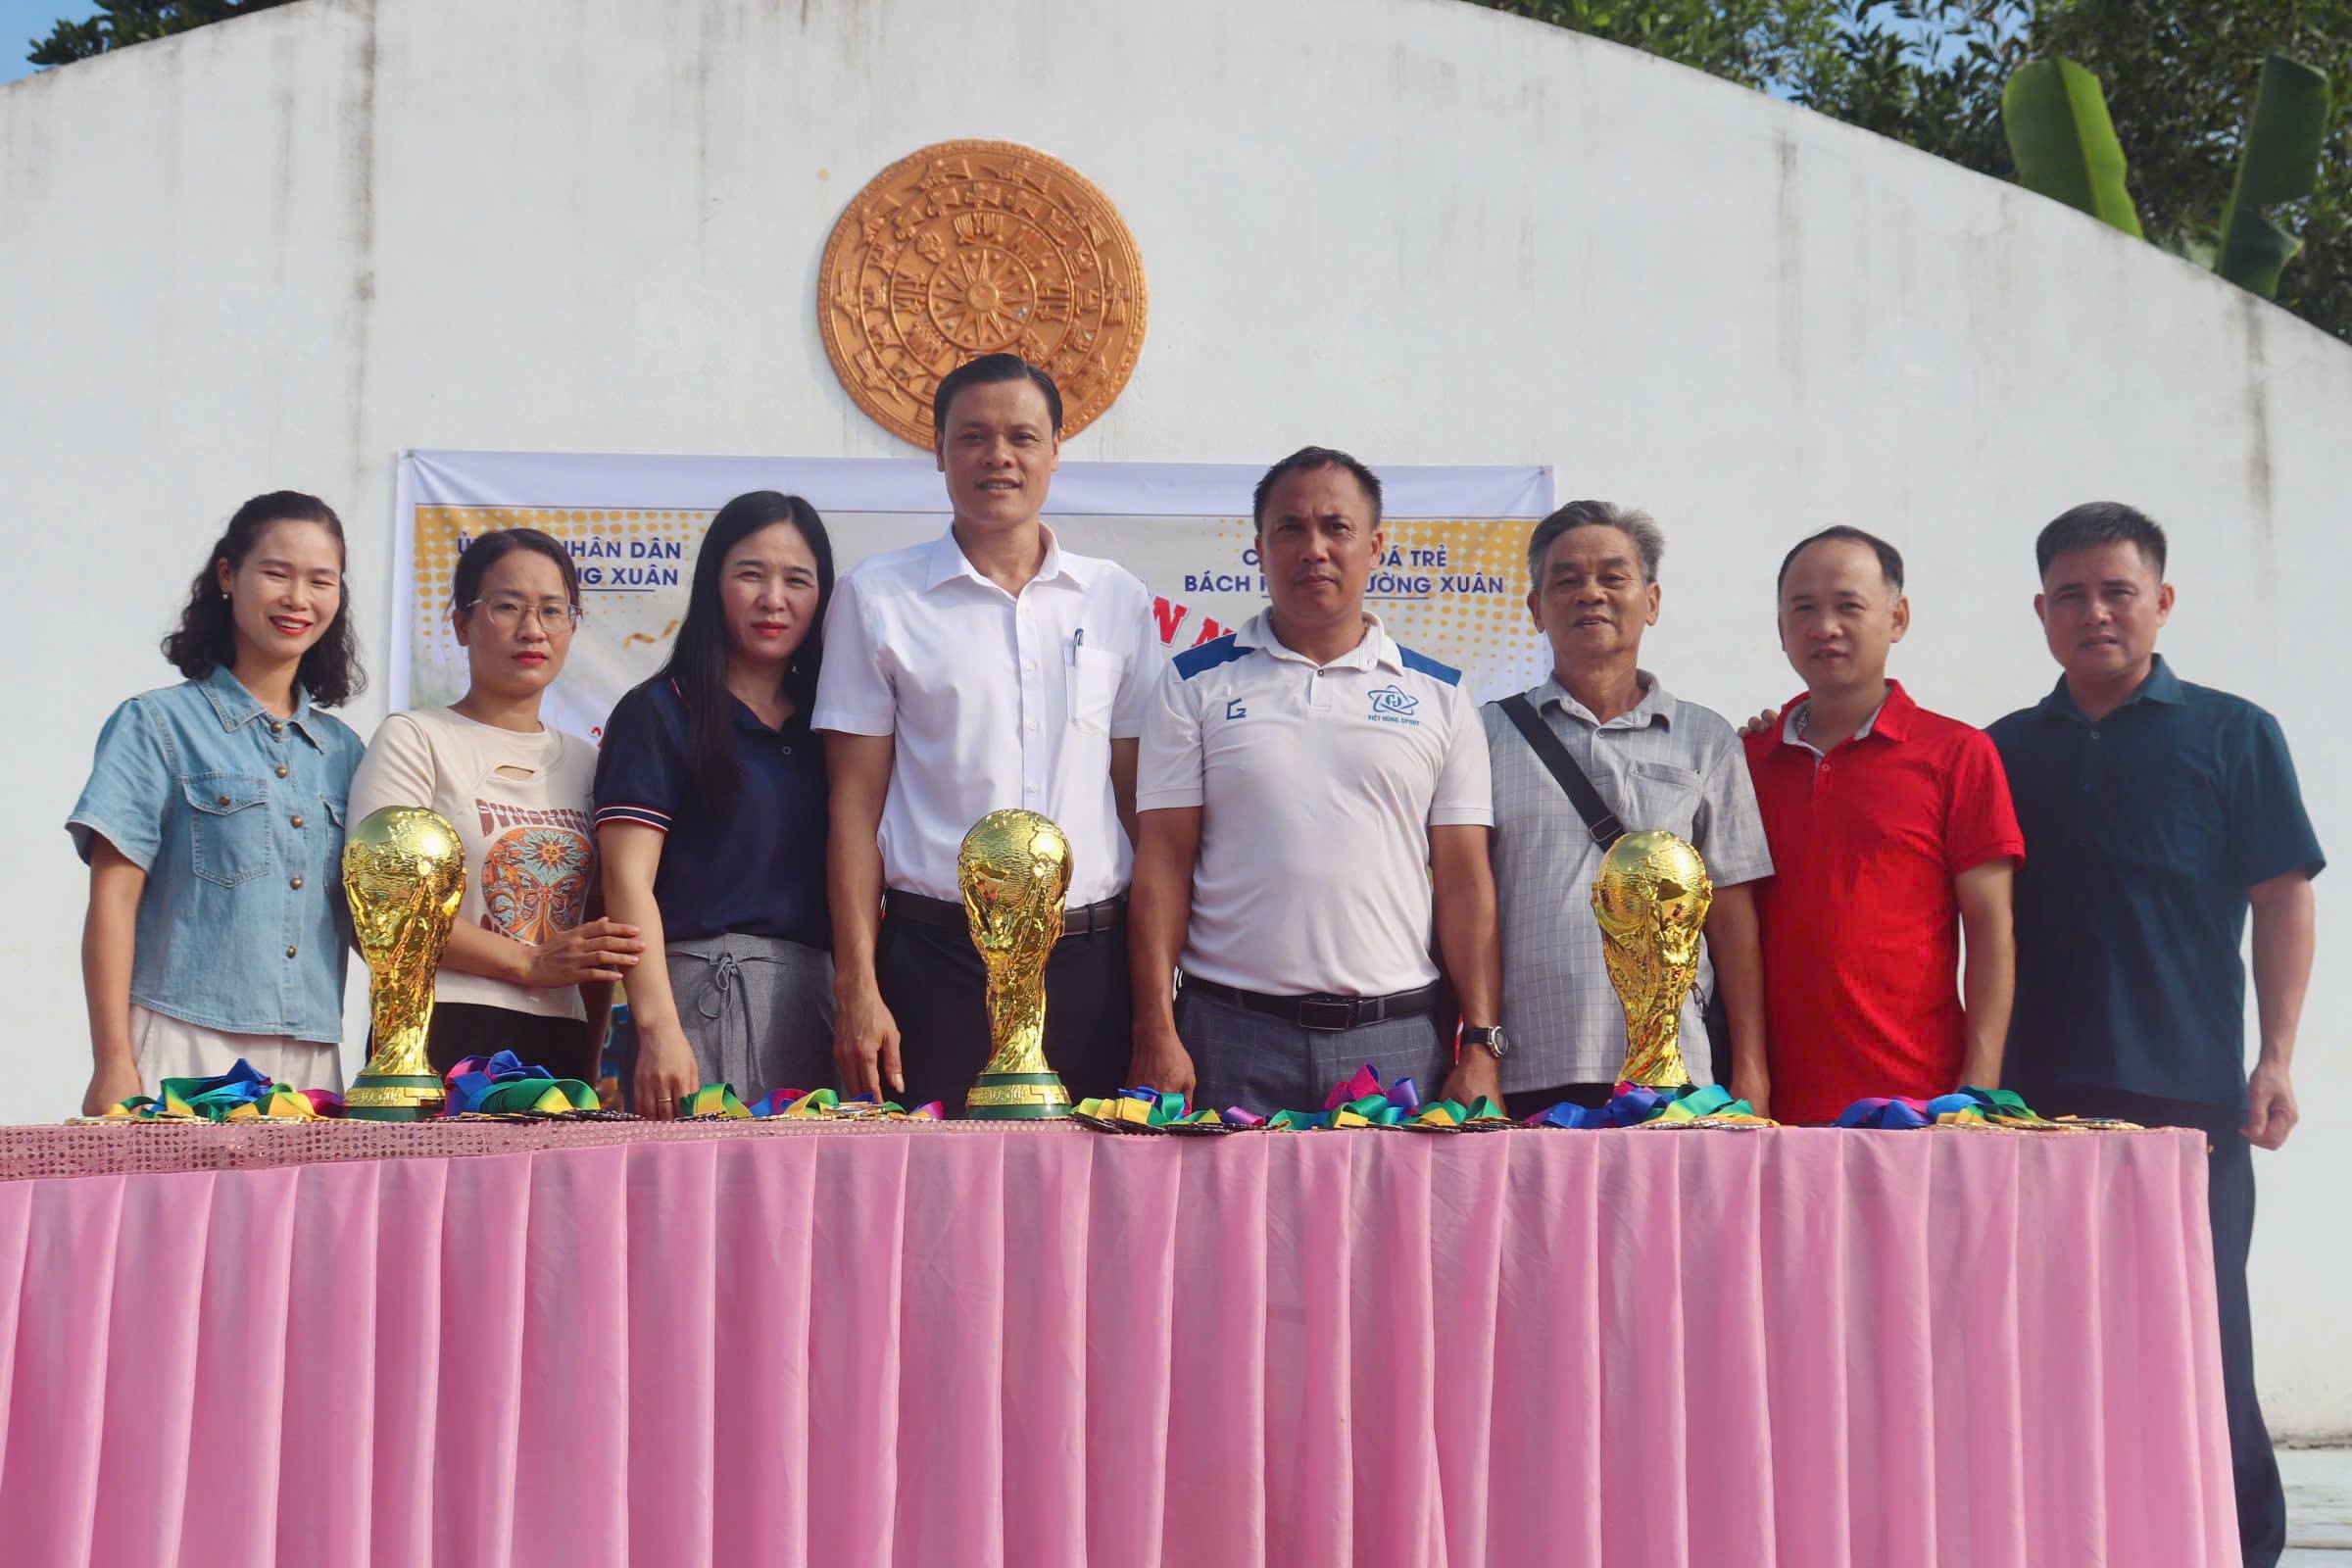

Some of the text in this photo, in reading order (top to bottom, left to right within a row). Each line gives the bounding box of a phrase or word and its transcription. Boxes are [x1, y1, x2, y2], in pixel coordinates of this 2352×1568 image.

[564, 536, 621, 558] HÂN
[630, 536, 681, 560] DÂN
[1410, 544, 1447, 566] TRẺ
[611, 564, 678, 586] XUÂN
[1184, 570, 1250, 592] BÁCH
[1365, 571, 1432, 594] ƯỜNG
[1440, 571, 1504, 594] XUÂN
[1400, 717, 1420, 727] SPORT
